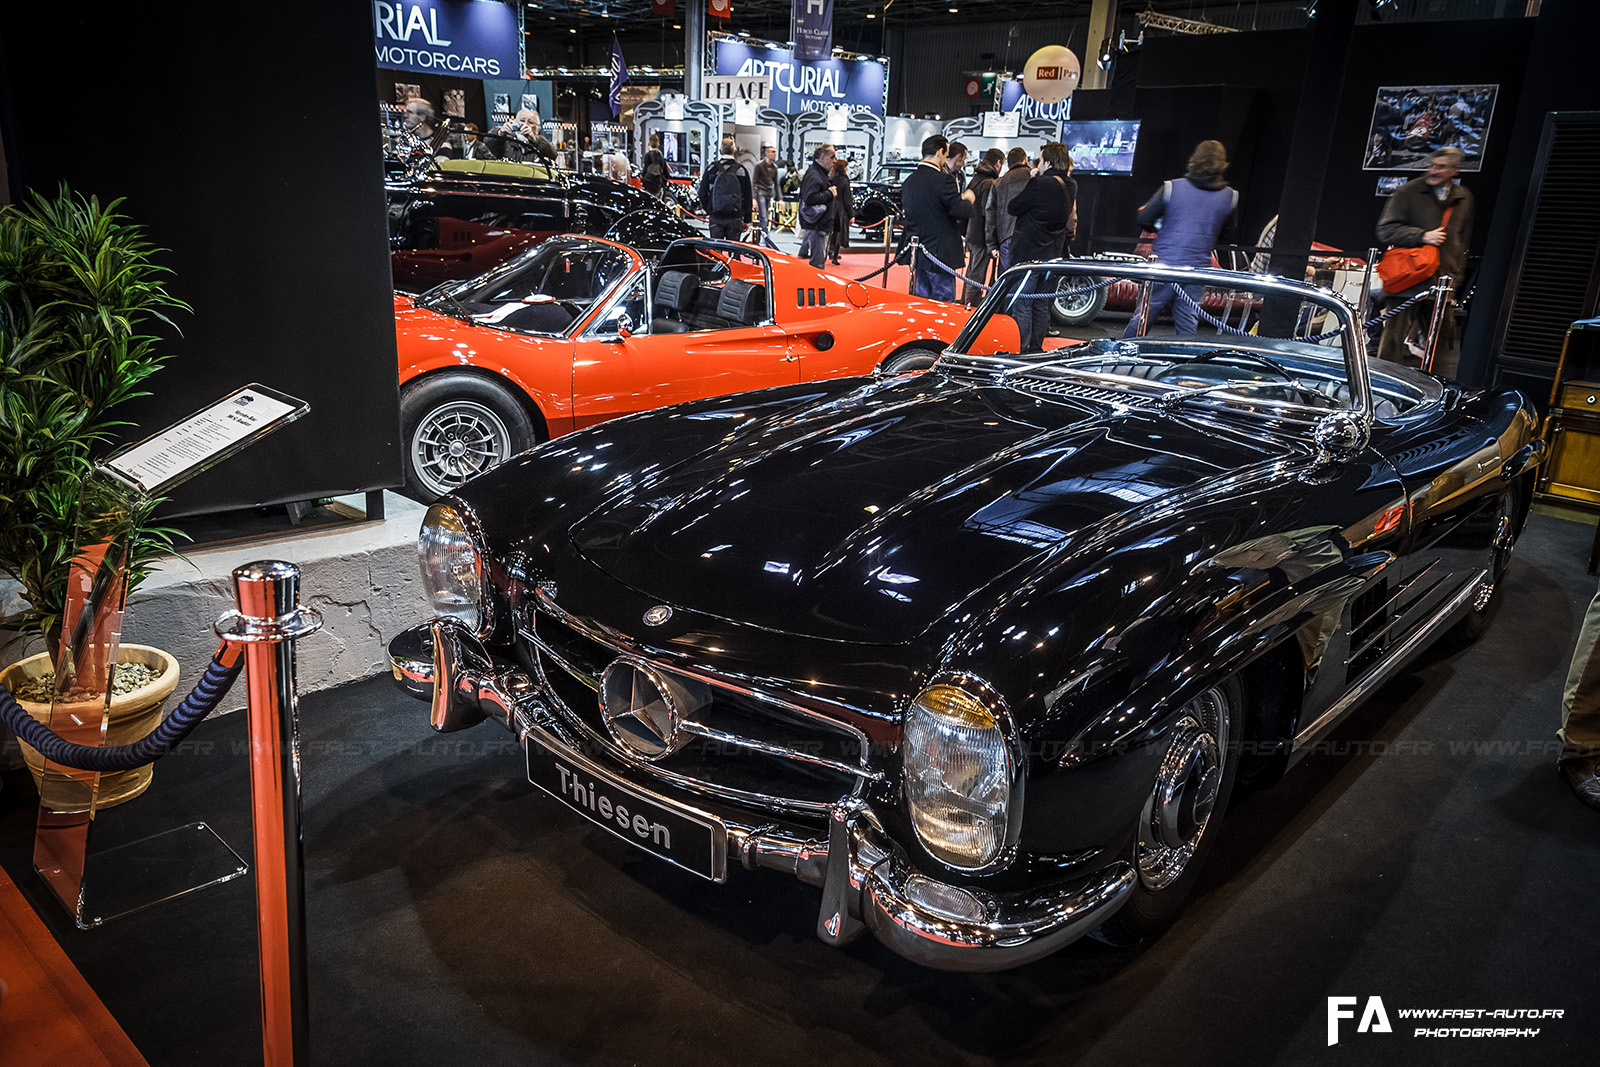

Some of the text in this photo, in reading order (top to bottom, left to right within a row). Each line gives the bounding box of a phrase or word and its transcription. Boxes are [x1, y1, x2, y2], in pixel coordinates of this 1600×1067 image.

[375, 45, 501, 76] MOTORCARS
[1038, 68, 1055, 78] Red
[705, 81, 769, 101] DELAGE
[555, 762, 671, 850] Thiesen
